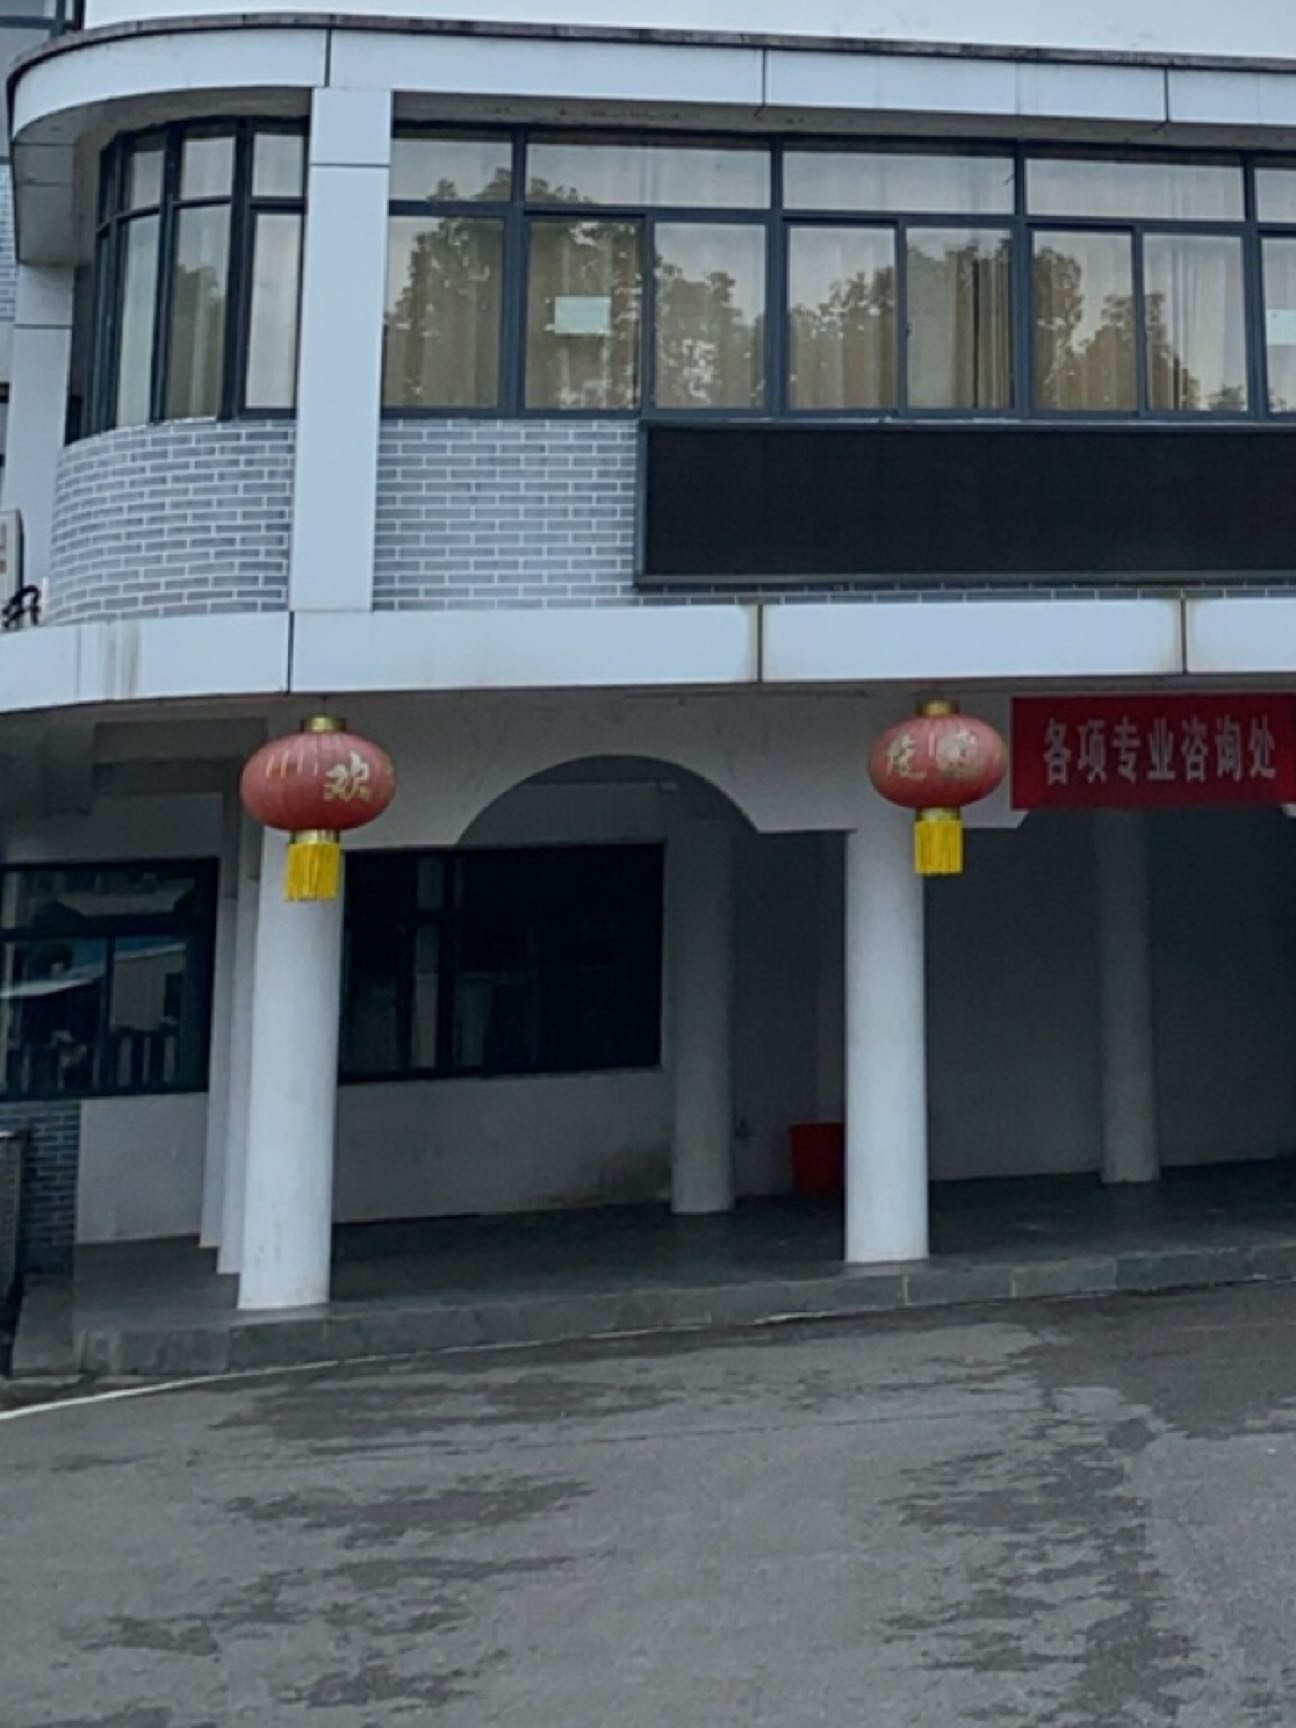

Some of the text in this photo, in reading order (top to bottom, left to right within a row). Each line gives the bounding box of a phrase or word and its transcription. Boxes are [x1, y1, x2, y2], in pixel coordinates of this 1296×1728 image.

[322, 749, 372, 803] 欢
[1042, 713, 1277, 786] 各项专业咨询处
